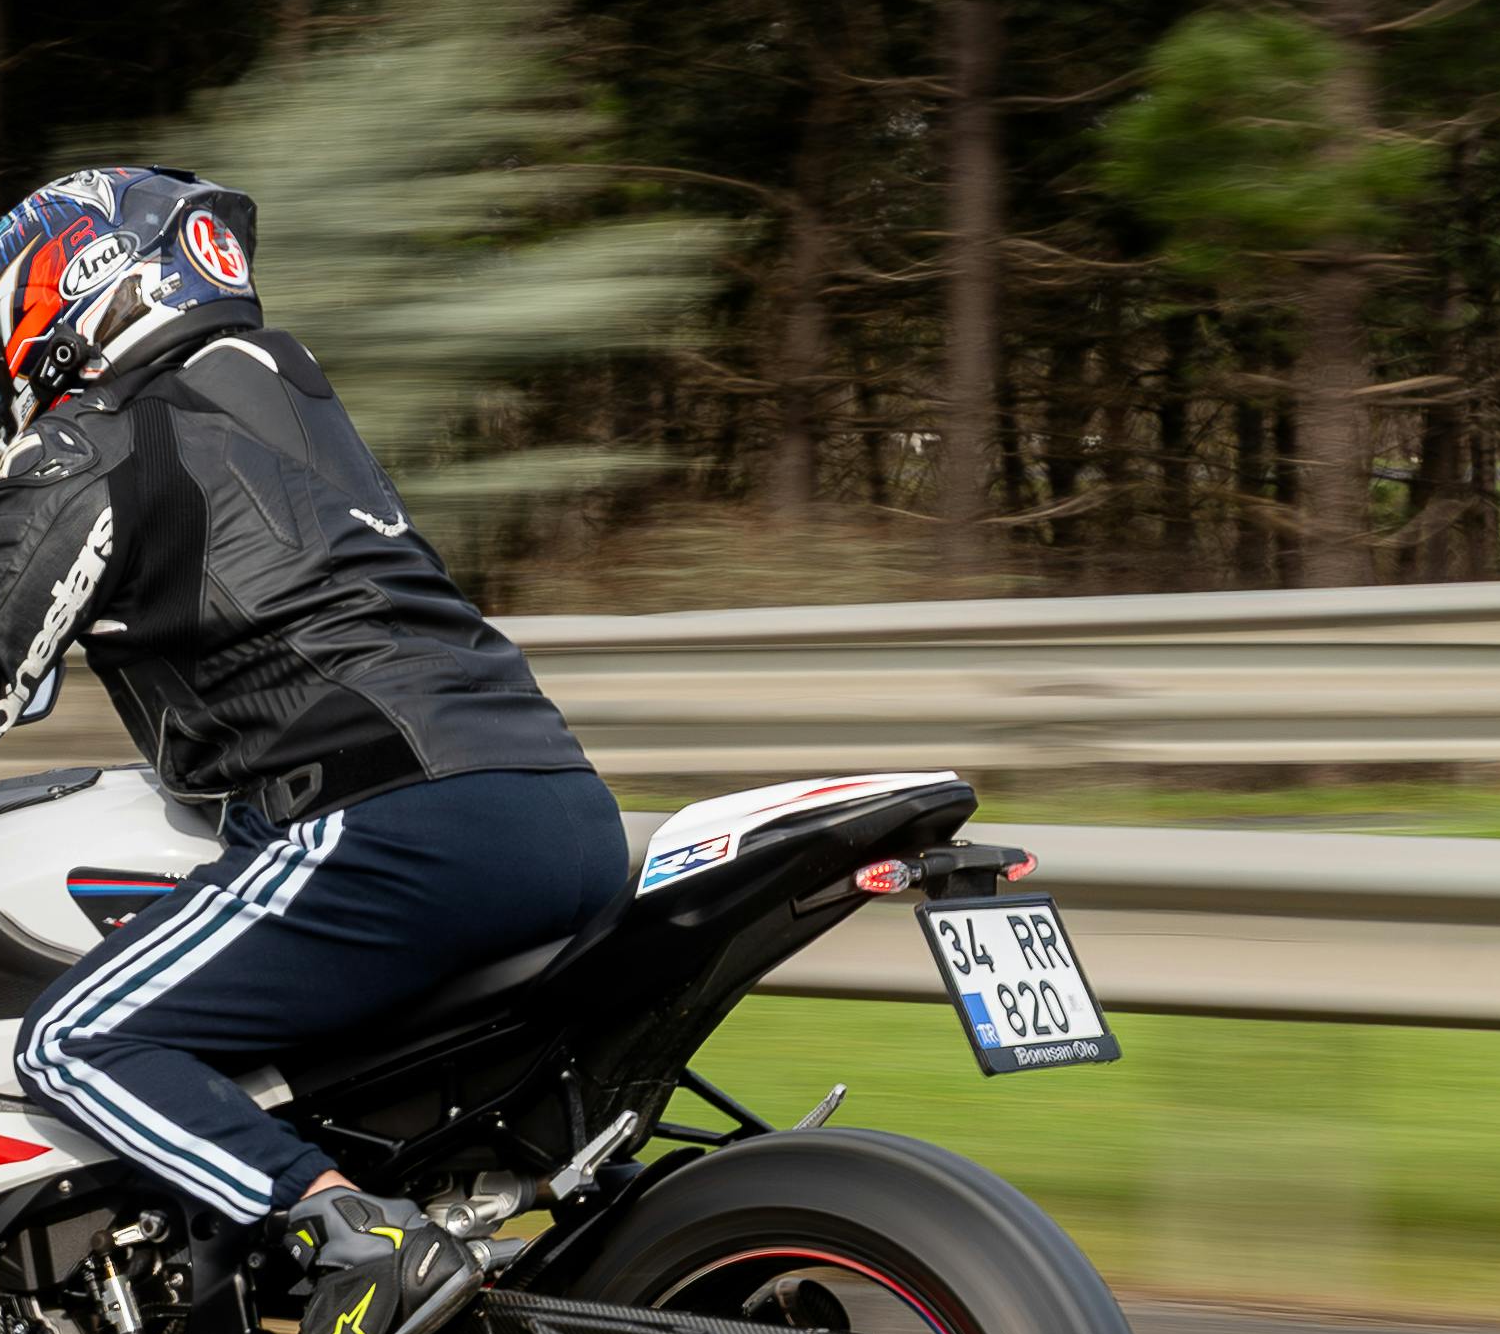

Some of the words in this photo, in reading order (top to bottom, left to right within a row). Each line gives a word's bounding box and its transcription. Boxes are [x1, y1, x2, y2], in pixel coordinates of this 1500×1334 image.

[646, 835, 730, 881] RR
[939, 918, 996, 975] 34
[1006, 914, 1071, 970] RR
[997, 979, 1070, 1038] 820
[976, 1023, 1000, 1045] TR
[1013, 1045, 1074, 1066] Borusan
